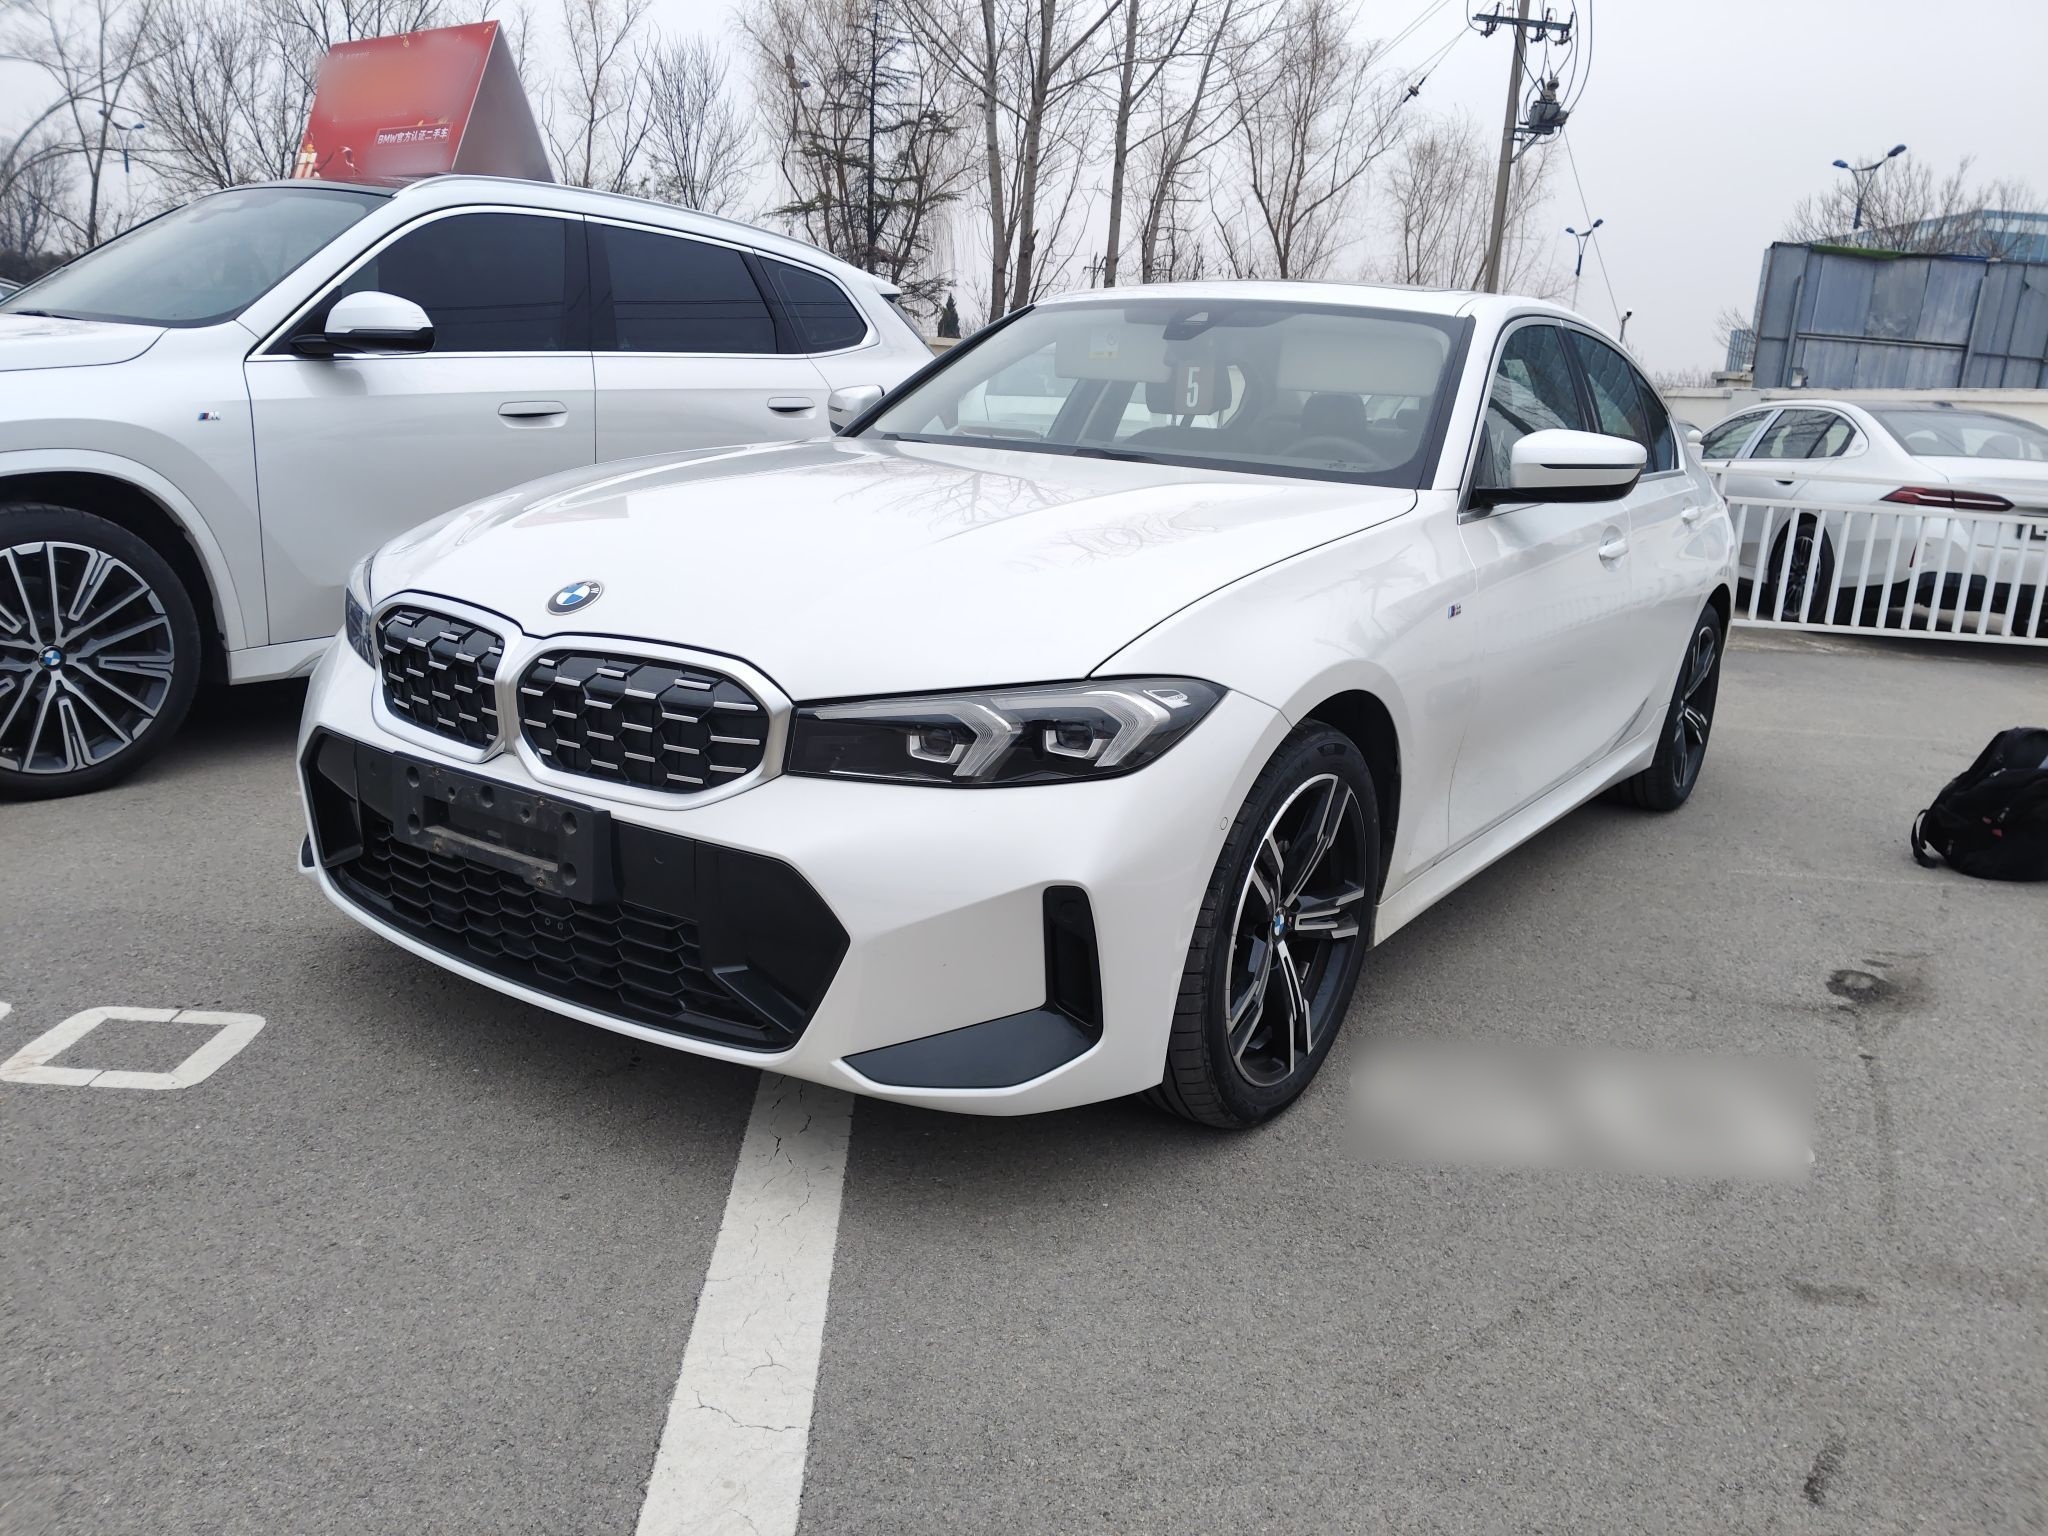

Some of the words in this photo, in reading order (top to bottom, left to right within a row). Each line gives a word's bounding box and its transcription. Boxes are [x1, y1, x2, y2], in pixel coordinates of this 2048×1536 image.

[377, 128, 449, 144] BMW官方认证二手车
[1186, 366, 1201, 408] 5
